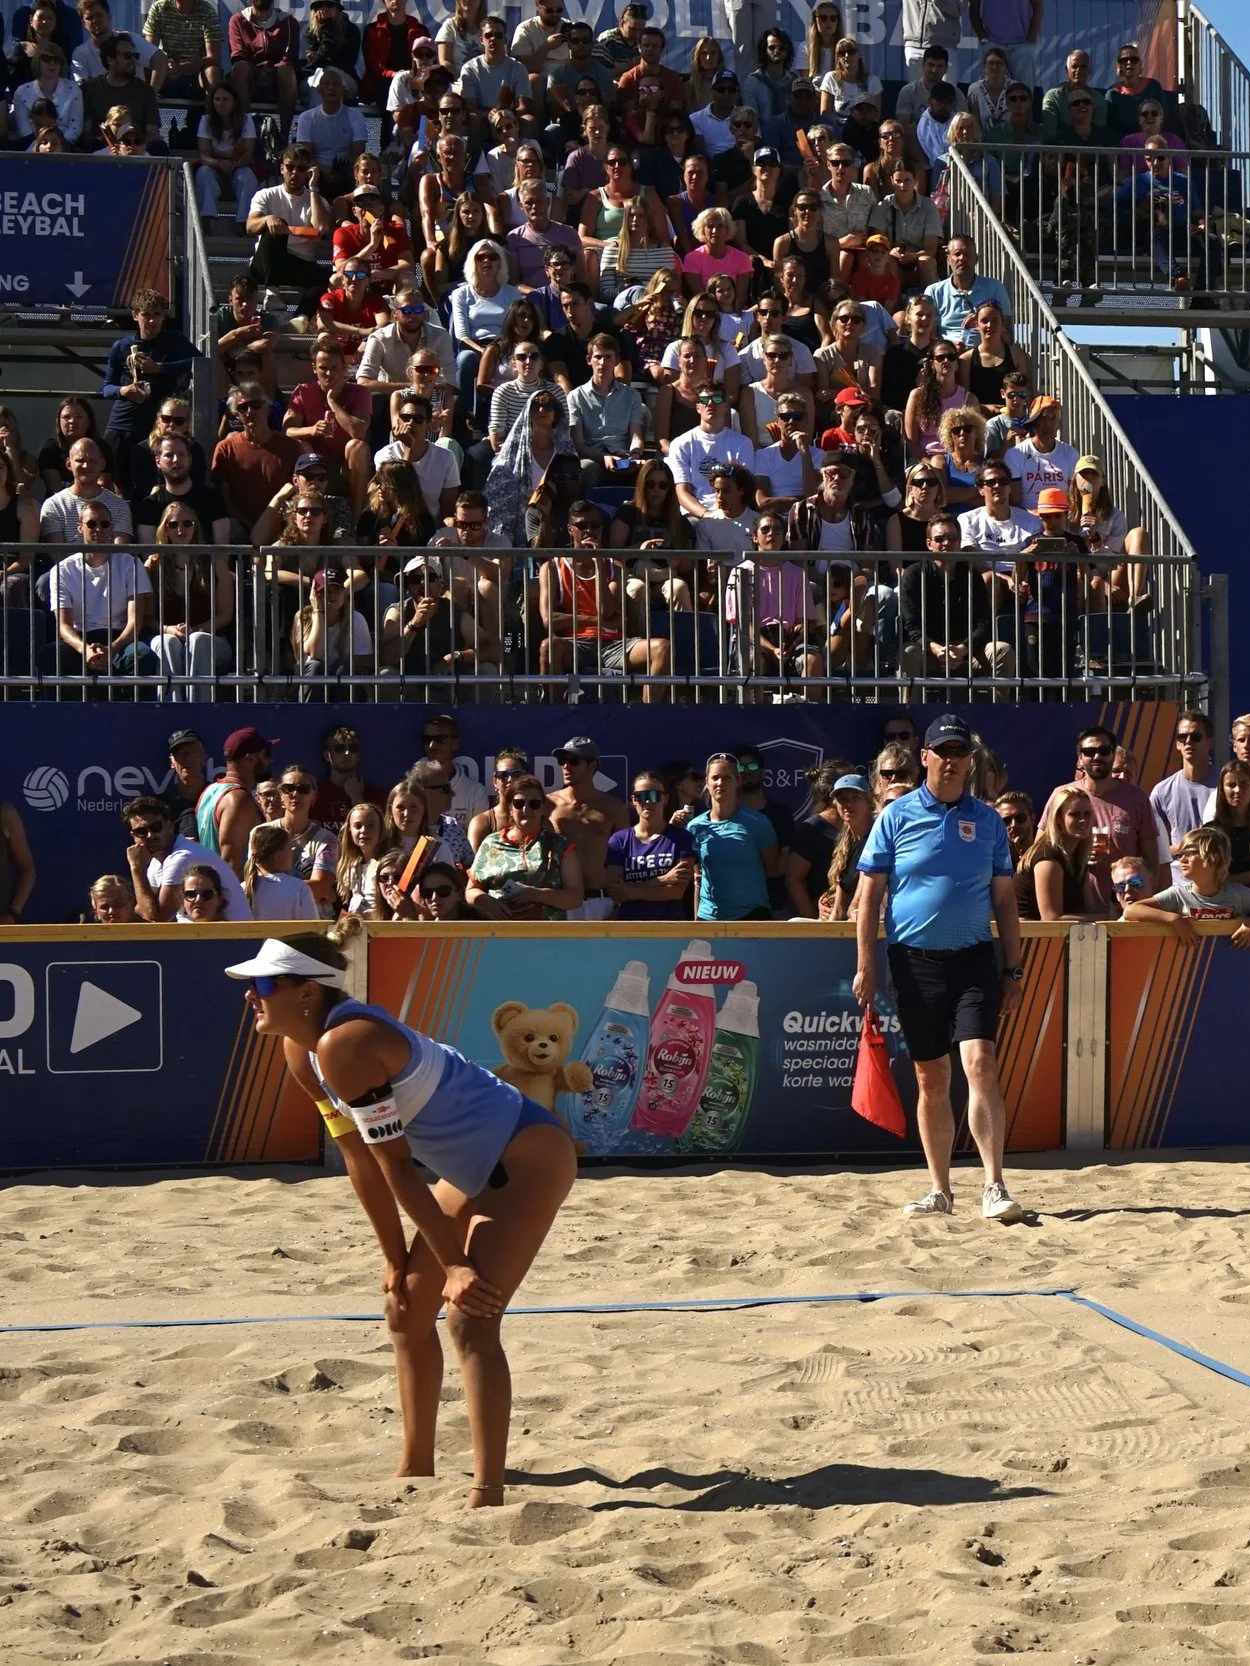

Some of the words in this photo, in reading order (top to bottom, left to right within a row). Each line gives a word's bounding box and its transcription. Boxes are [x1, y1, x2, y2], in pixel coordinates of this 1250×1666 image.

[0, 191, 85, 216] EACH
[0, 215, 85, 237] EYBAL
[1026, 472, 1064, 482] PARIS
[683, 965, 740, 979] NIEUW
[784, 1036, 861, 1051] wasmidd
[783, 1055, 855, 1072] speciaal
[782, 1074, 823, 1088] korte
